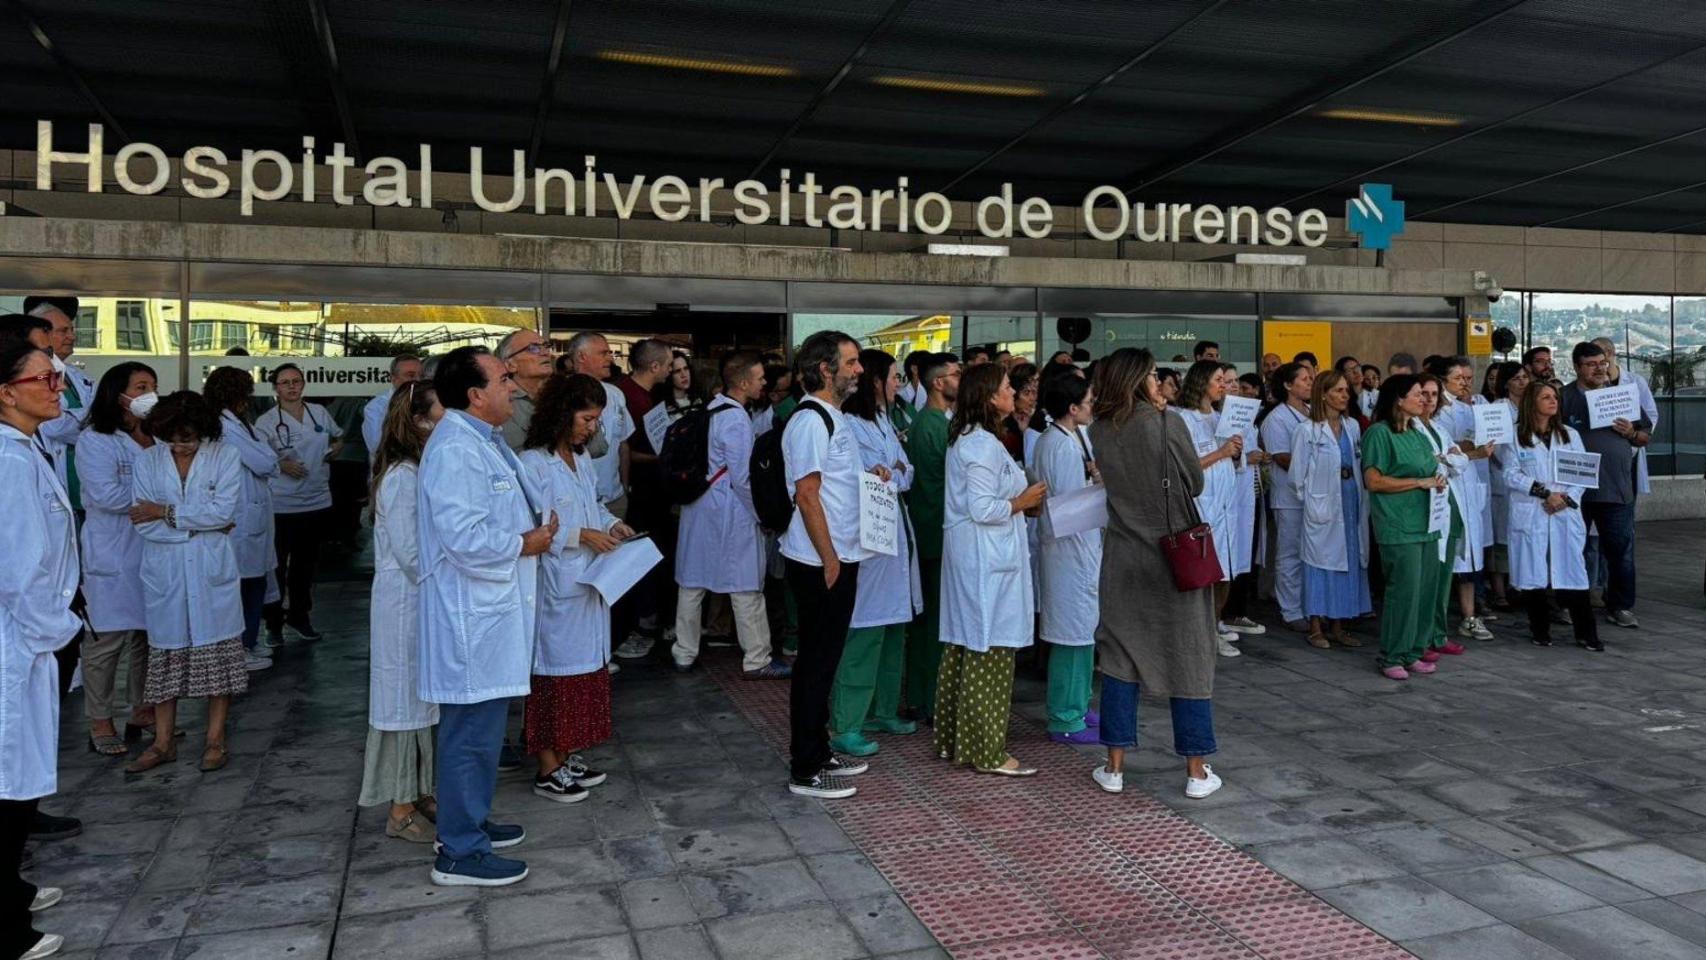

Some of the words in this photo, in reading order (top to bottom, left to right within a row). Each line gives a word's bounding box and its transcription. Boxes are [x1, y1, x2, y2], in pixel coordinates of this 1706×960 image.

[37, 120, 432, 216] Hospital
[470, 146, 952, 235] Universitario
[977, 183, 1053, 239] de
[1083, 186, 1328, 246] Ourense
